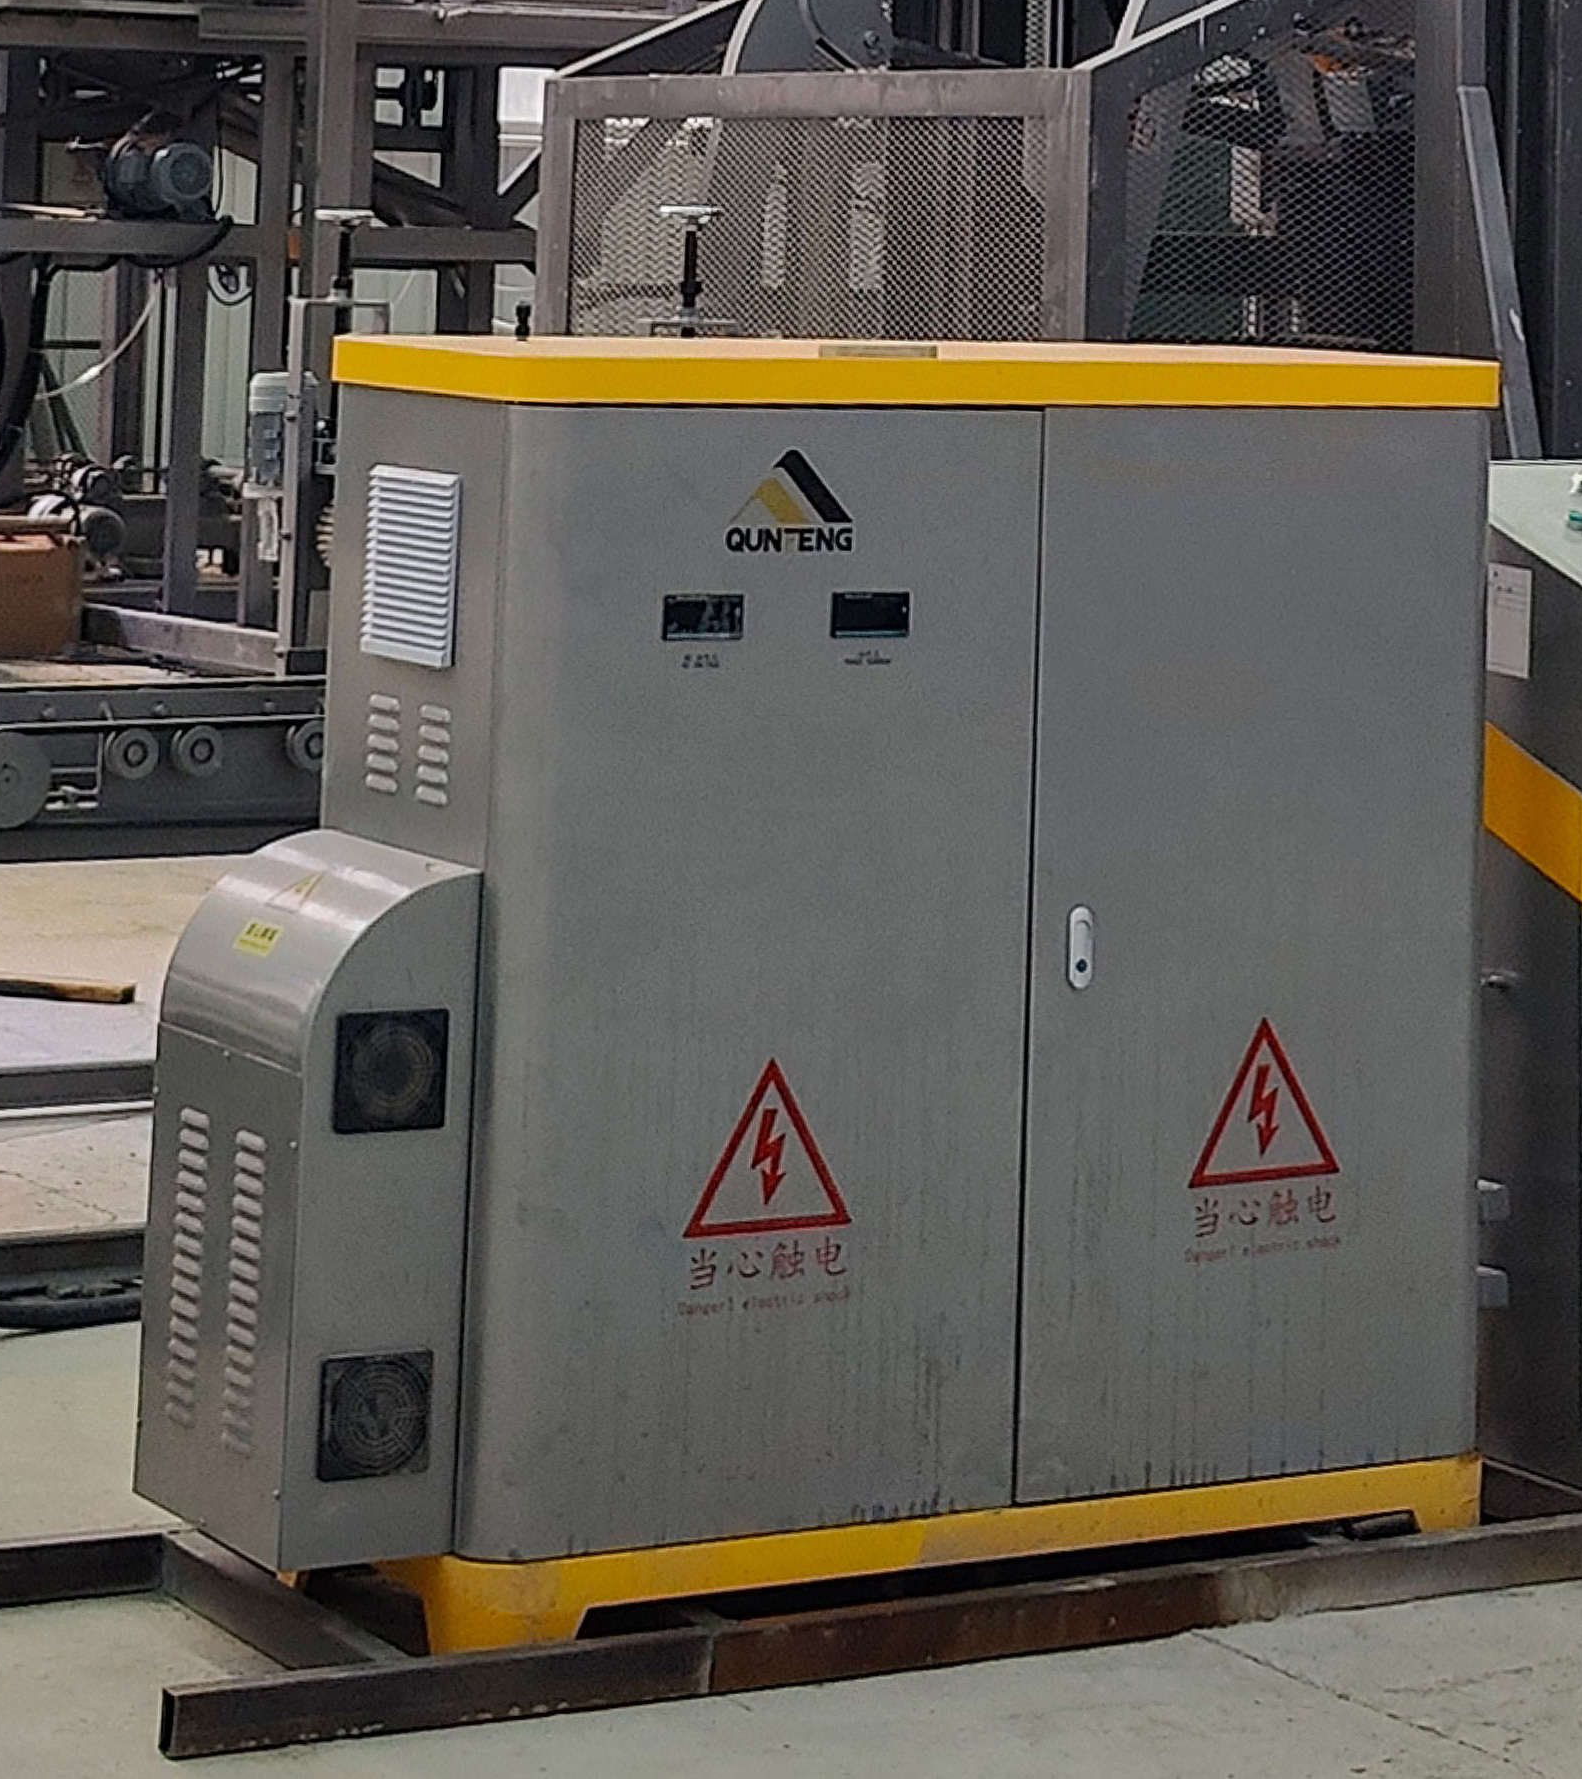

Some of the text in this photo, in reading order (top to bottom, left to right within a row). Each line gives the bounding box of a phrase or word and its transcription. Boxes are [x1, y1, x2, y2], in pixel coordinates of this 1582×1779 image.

[1194, 1186, 1336, 1238] 当心触电
[689, 1236, 847, 1290] 当心触电
